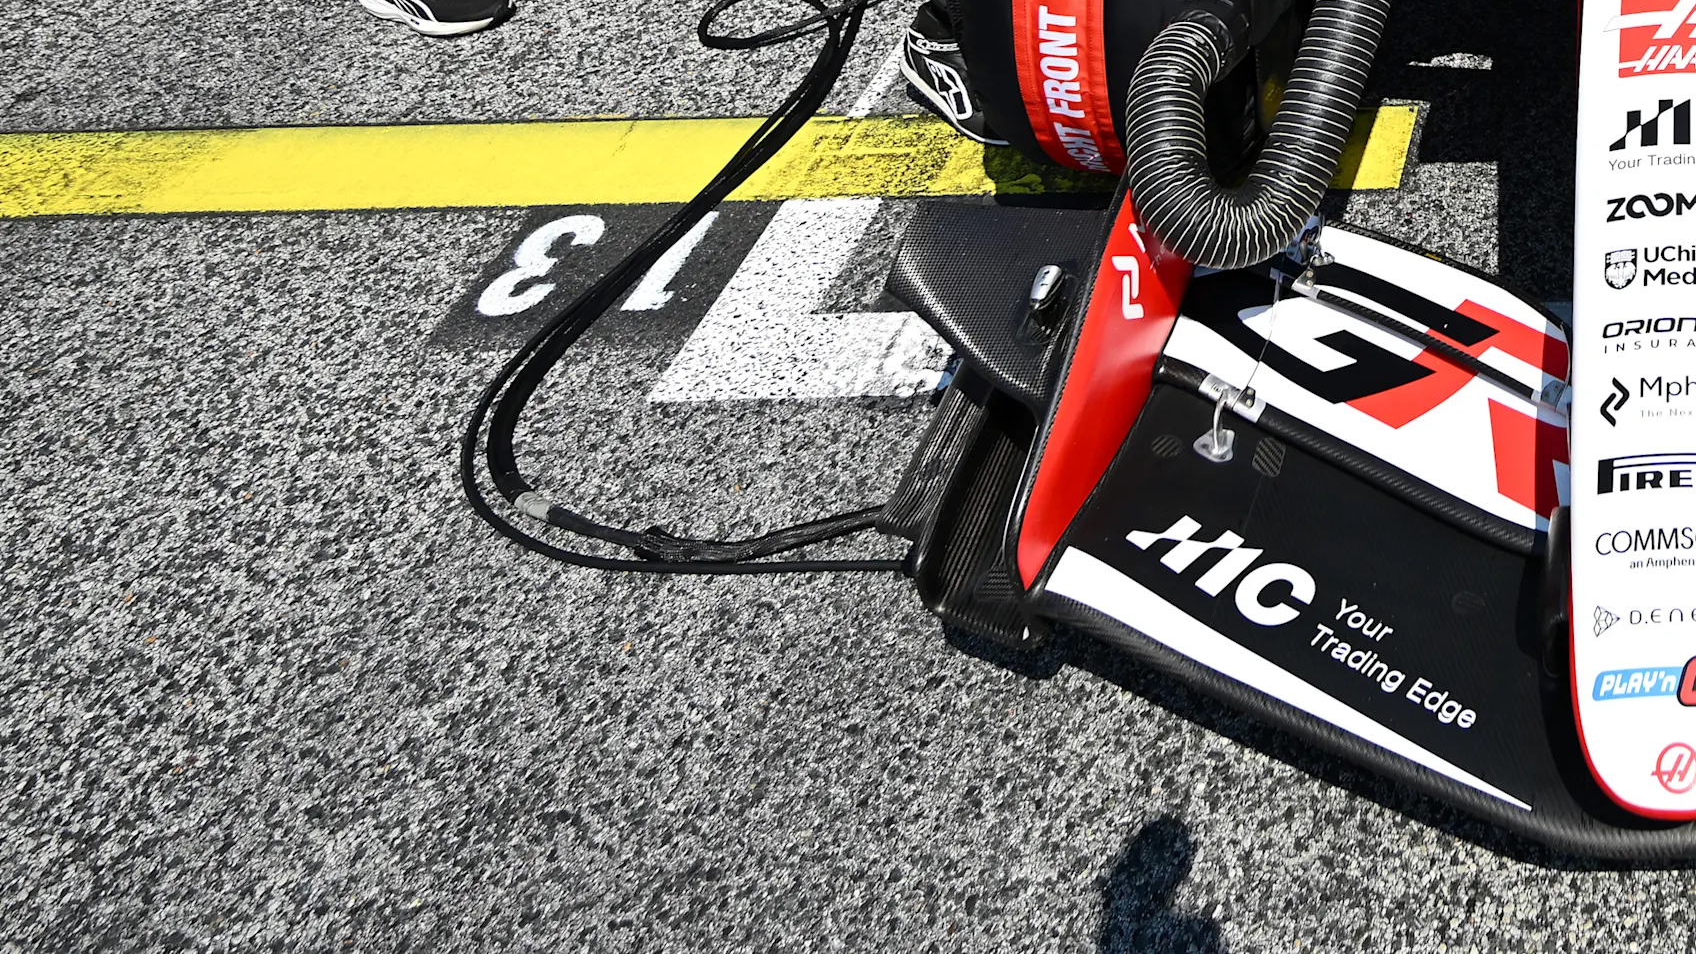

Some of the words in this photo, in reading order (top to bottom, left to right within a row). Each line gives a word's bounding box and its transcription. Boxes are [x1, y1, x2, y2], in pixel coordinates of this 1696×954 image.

[1038, 5, 1085, 120] FRONT
[1608, 157, 1642, 171] Your
[476, 211, 719, 316] 13
[1640, 409, 1663, 418] The
[1629, 559, 1644, 570] an
[1335, 598, 1393, 643] Your
[1309, 623, 1405, 694] Trading
[1406, 678, 1477, 729] Edge
[1599, 671, 1677, 697] PLAY'n
